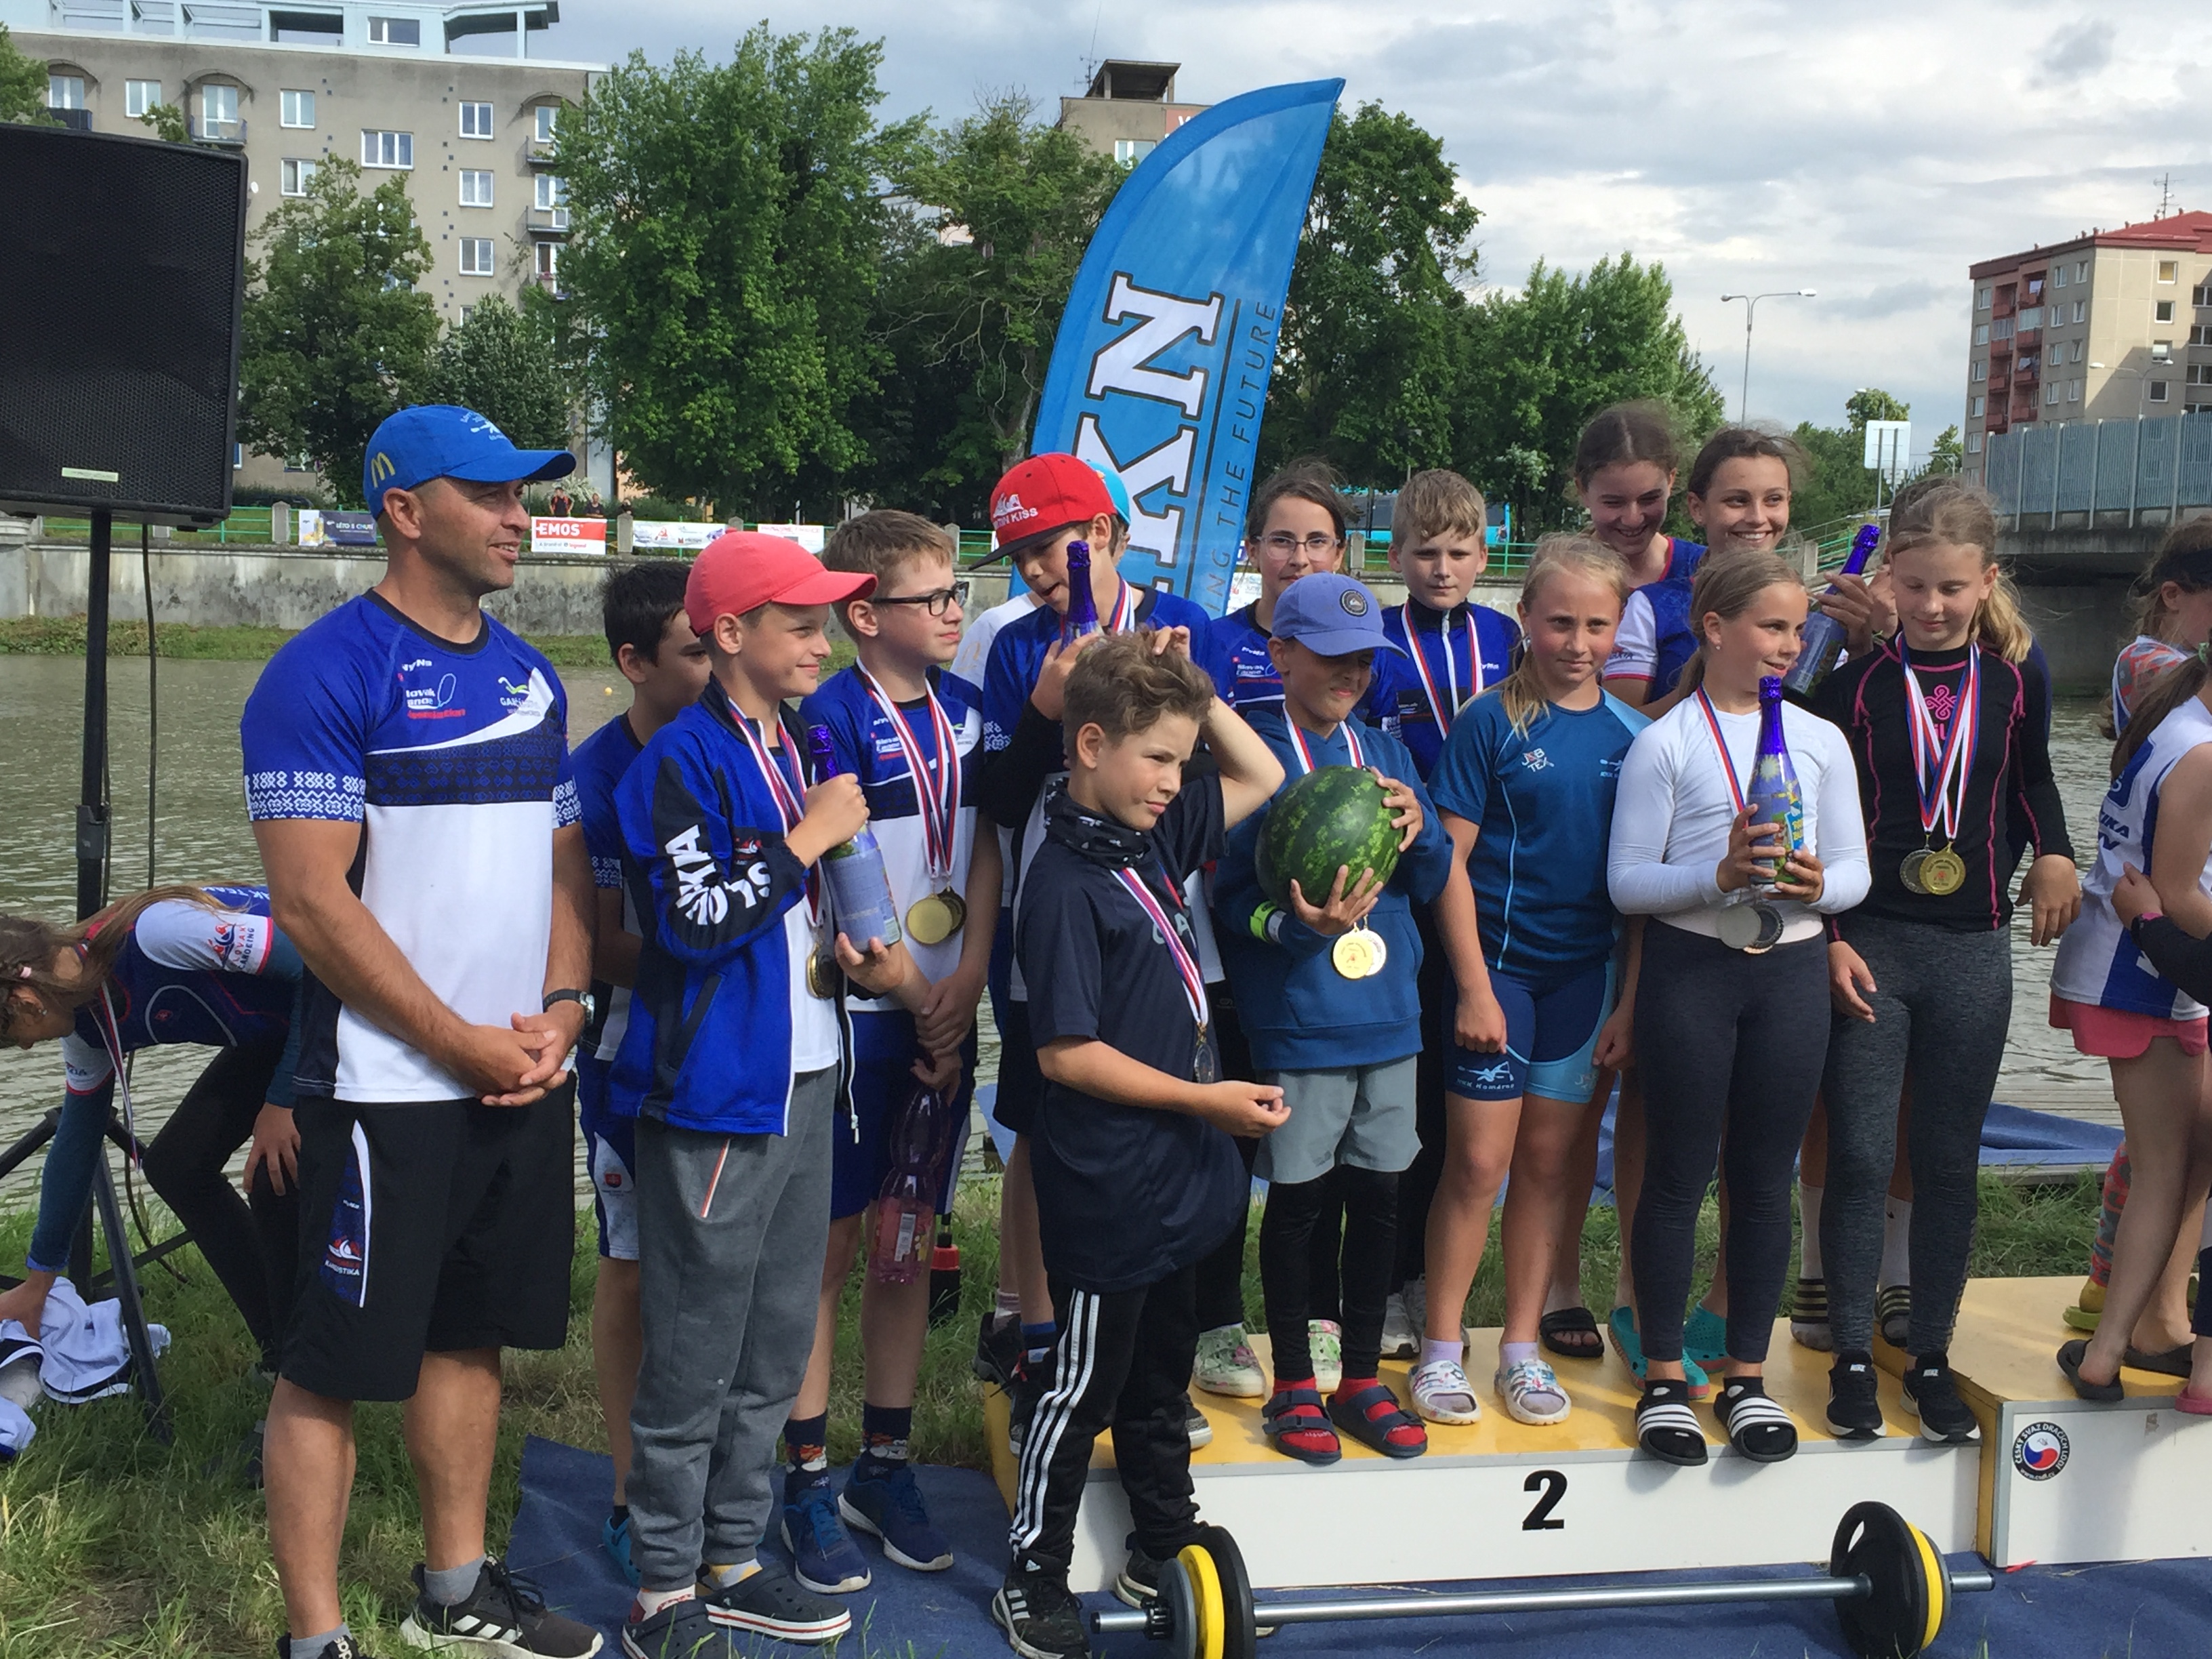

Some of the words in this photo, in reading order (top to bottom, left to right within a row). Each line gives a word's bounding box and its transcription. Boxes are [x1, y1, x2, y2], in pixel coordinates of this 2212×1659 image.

[1231, 302, 1276, 444] FUTURE
[1010, 508, 1038, 523] KISS
[1216, 460, 1246, 529] THE
[537, 523, 581, 536] EMOS
[1204, 548, 1231, 613] ING
[2022, 1424, 2041, 1439] SVAZ
[1522, 1469, 1568, 1531] 2
